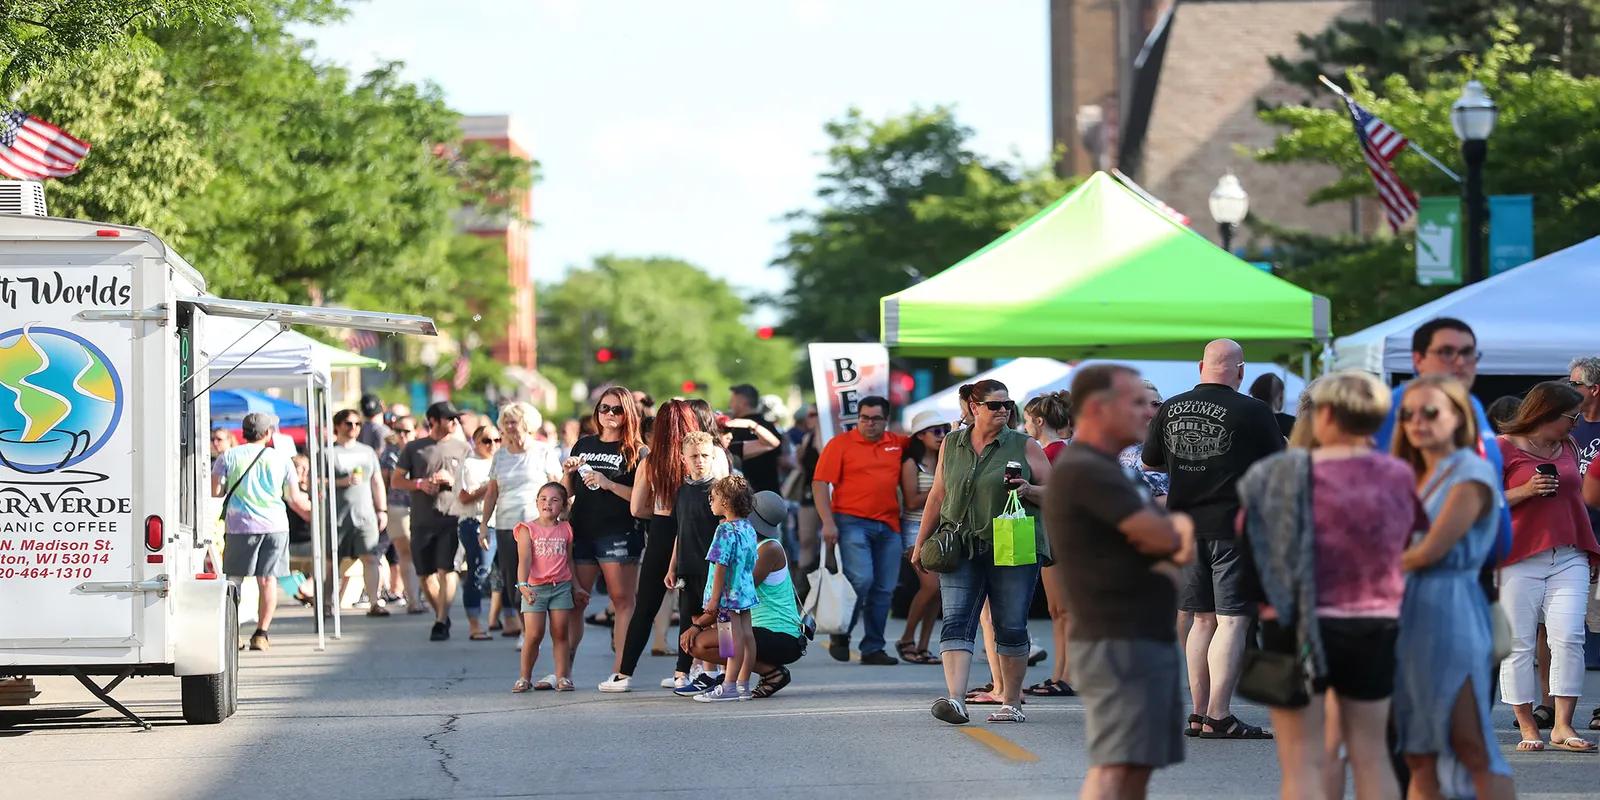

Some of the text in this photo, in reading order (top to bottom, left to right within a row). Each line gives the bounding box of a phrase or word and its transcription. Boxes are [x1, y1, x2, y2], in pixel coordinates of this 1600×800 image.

[0, 271, 131, 309] th Worlds
[1168, 404, 1227, 422] COZUMEL
[0, 487, 131, 518] RAVERDE
[0, 521, 117, 532] ANIC COFFEE
[0, 540, 114, 551] N. Madison St.
[36, 553, 57, 564] WI
[61, 553, 109, 564] 53014
